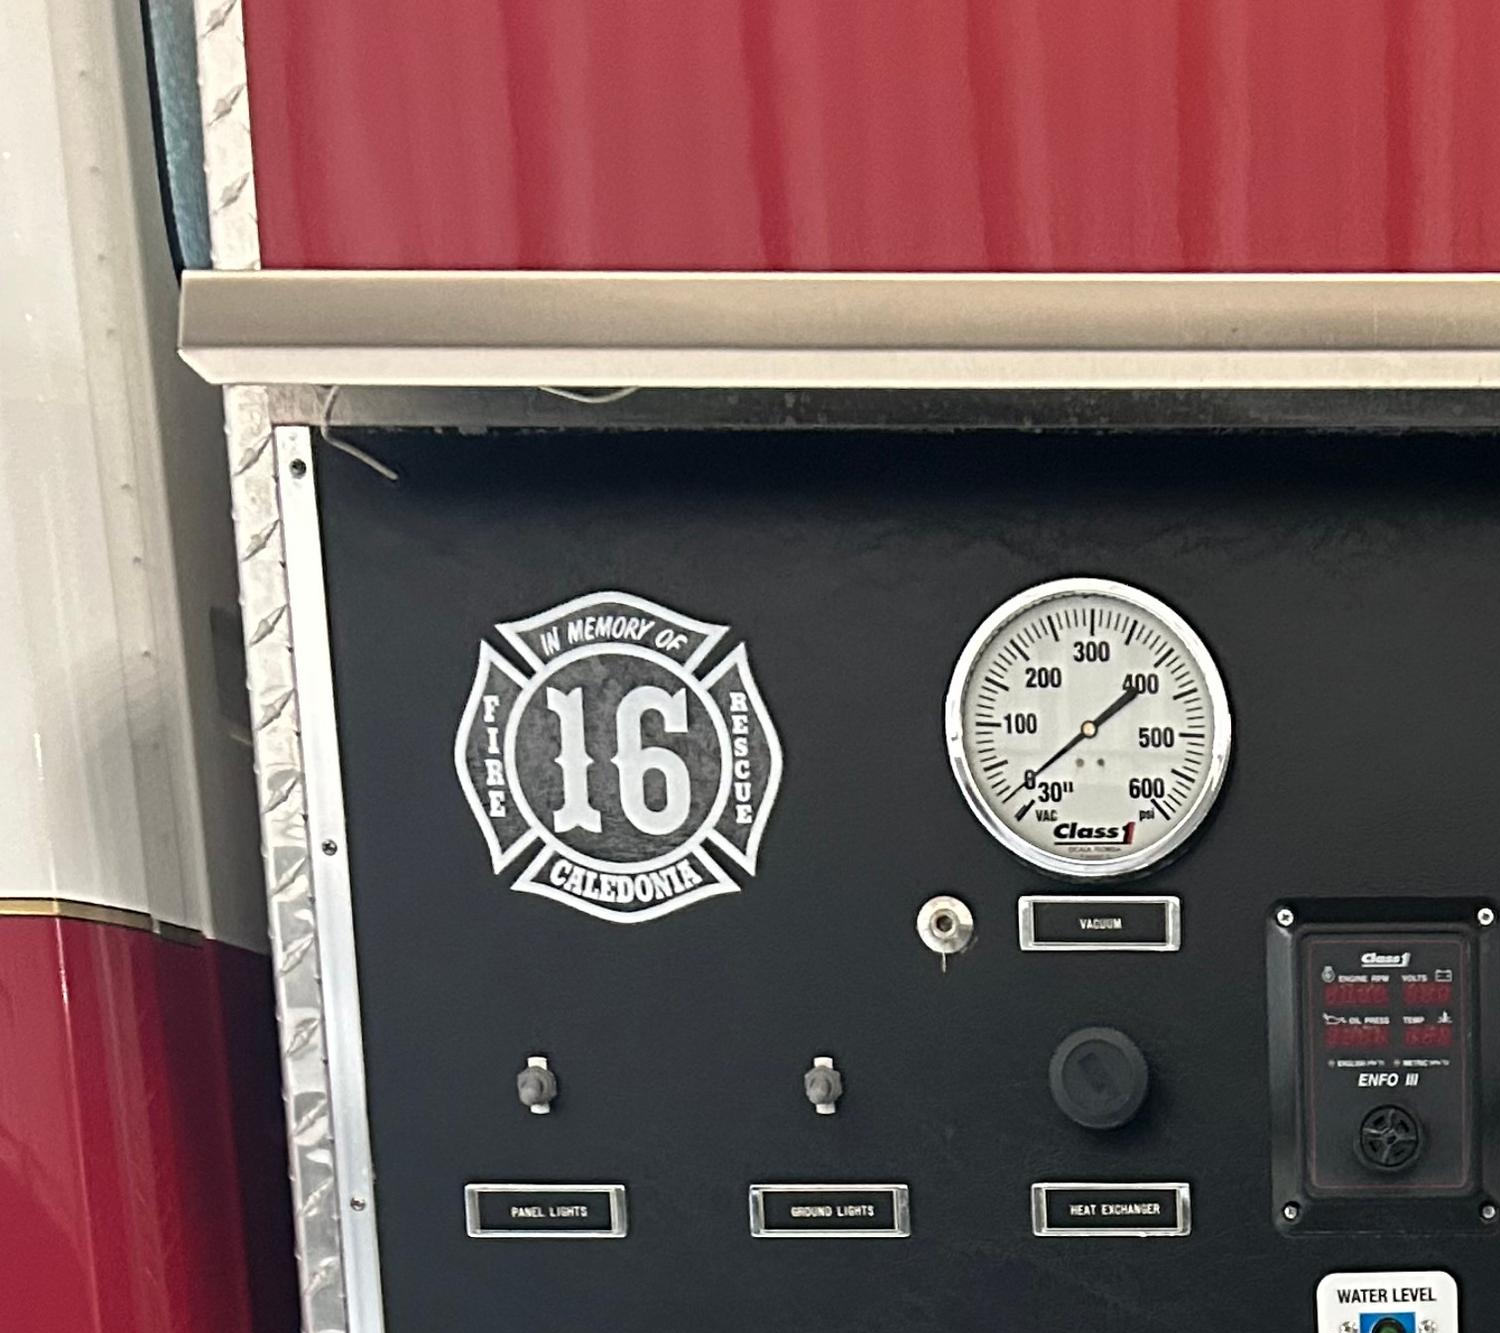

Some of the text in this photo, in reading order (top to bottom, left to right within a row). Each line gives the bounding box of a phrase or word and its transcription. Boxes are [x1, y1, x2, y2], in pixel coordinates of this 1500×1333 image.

[540, 616, 689, 657] IN MEMORY OF
[1073, 641, 1111, 663] 300
[1025, 667, 1062, 689] 200
[1122, 673, 1159, 695] 400
[1004, 713, 1038, 734] 100
[1138, 727, 1175, 748] 500
[483, 695, 506, 818] FIRE
[546, 685, 691, 836] 16
[729, 692, 752, 824] RESCUE
[1129, 778, 1165, 799] 600
[1036, 808, 1058, 822] VAC
[1139, 808, 1155, 822] psi
[550, 859, 703, 904] CALEDONIA
[1079, 917, 1122, 930] VACUUM
[1358, 1073, 1399, 1087] ENFO
[511, 1205, 588, 1218] PANEL LIGHTS
[791, 1204, 875, 1218] GROUND LIGHTS
[1069, 1203, 1161, 1216] HEAT EXCHANGER
[1337, 1288, 1437, 1303] WATER LEVEL
